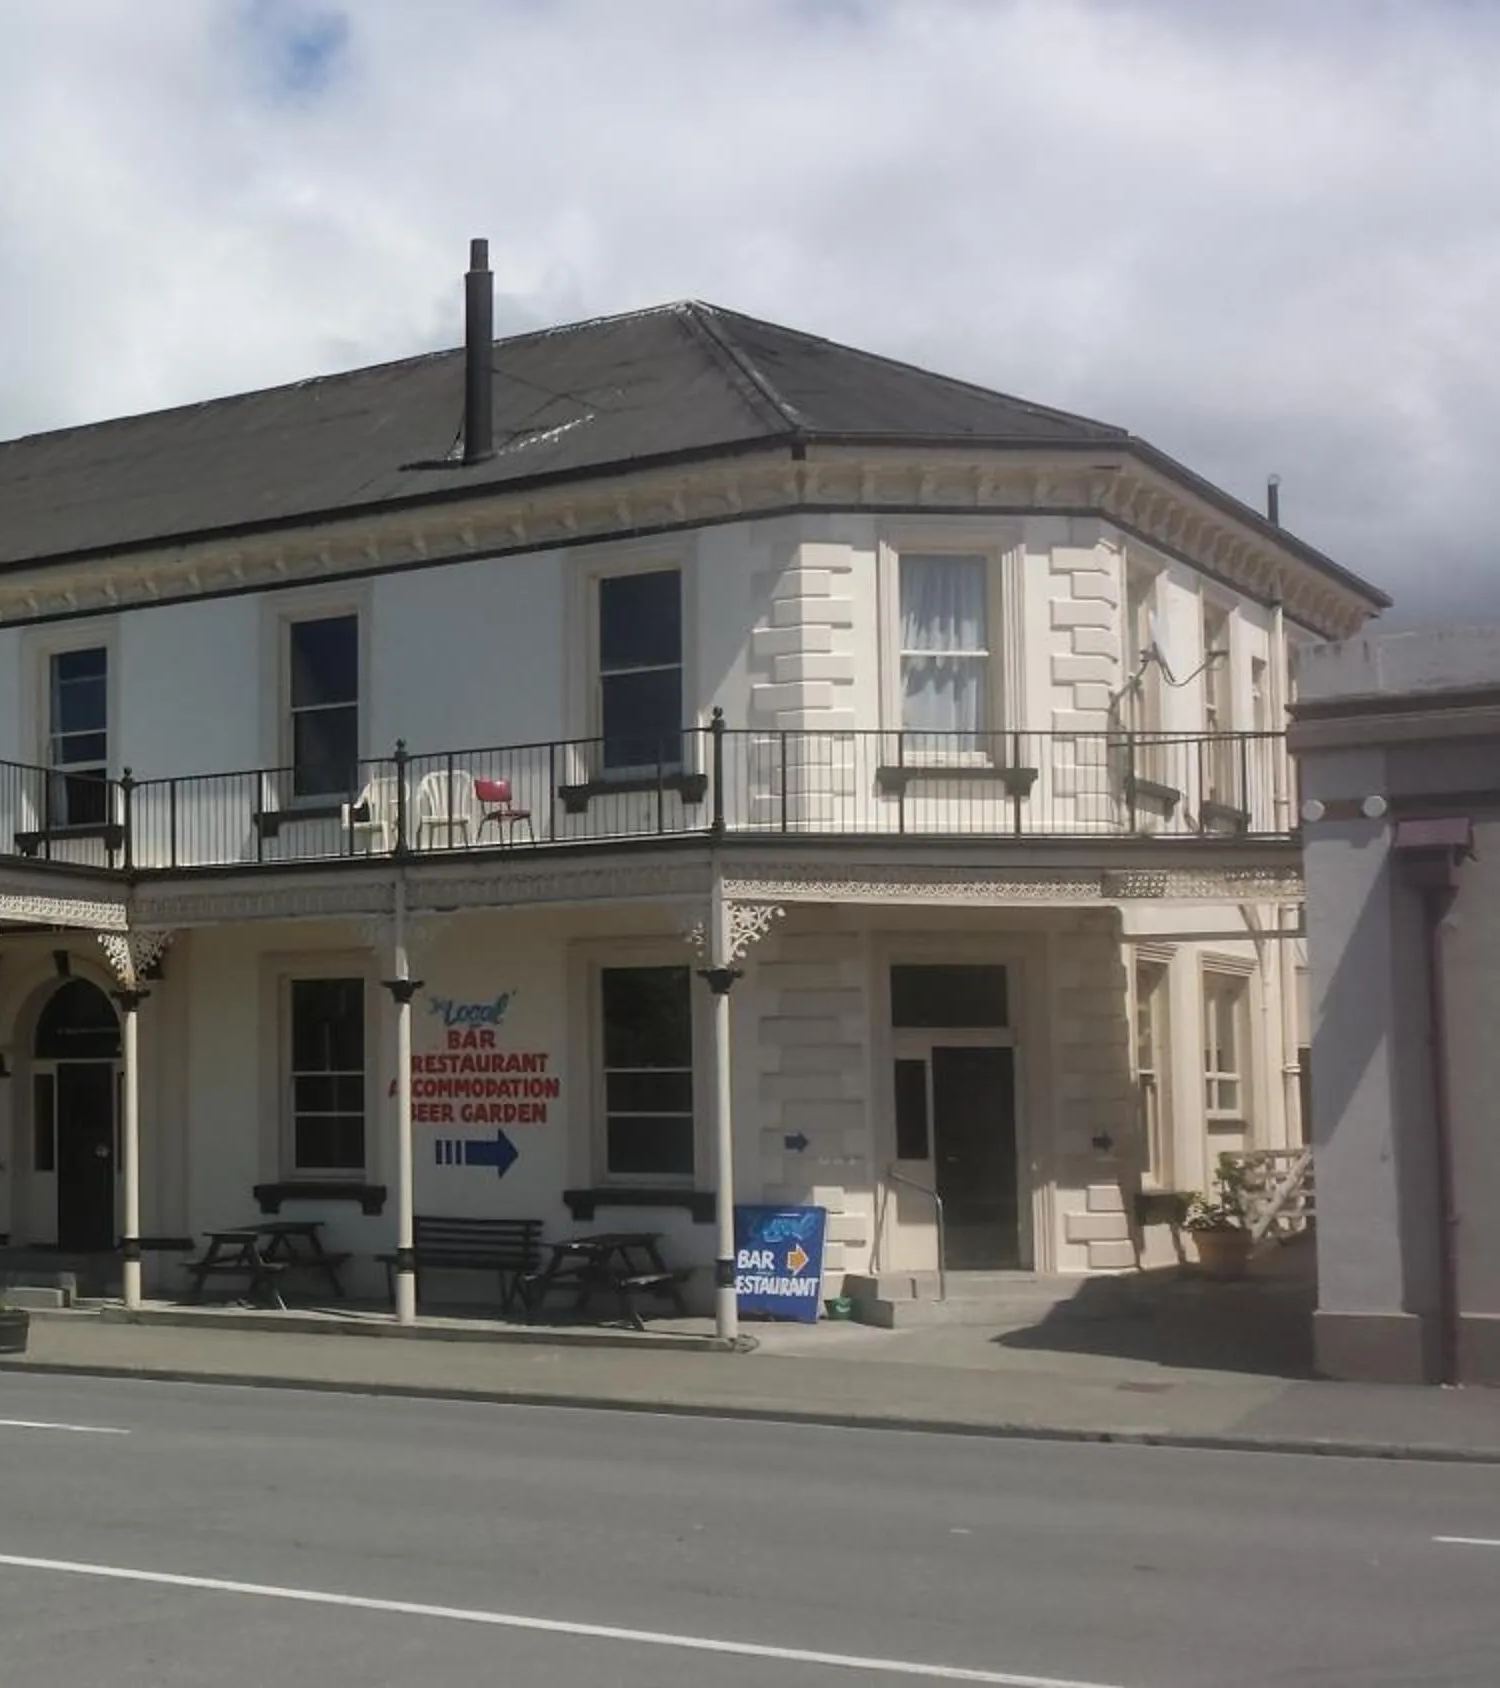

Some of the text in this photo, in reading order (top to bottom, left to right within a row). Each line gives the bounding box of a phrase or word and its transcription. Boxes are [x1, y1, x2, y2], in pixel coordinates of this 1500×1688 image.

[447, 1029, 496, 1050] BAR
[410, 1053, 549, 1074] RESTAURANT
[388, 1077, 561, 1099] ACOMMODATION
[460, 1102, 548, 1124] GARDEN
[737, 1248, 776, 1271] BAR
[735, 1274, 819, 1297] ESTAURANT
